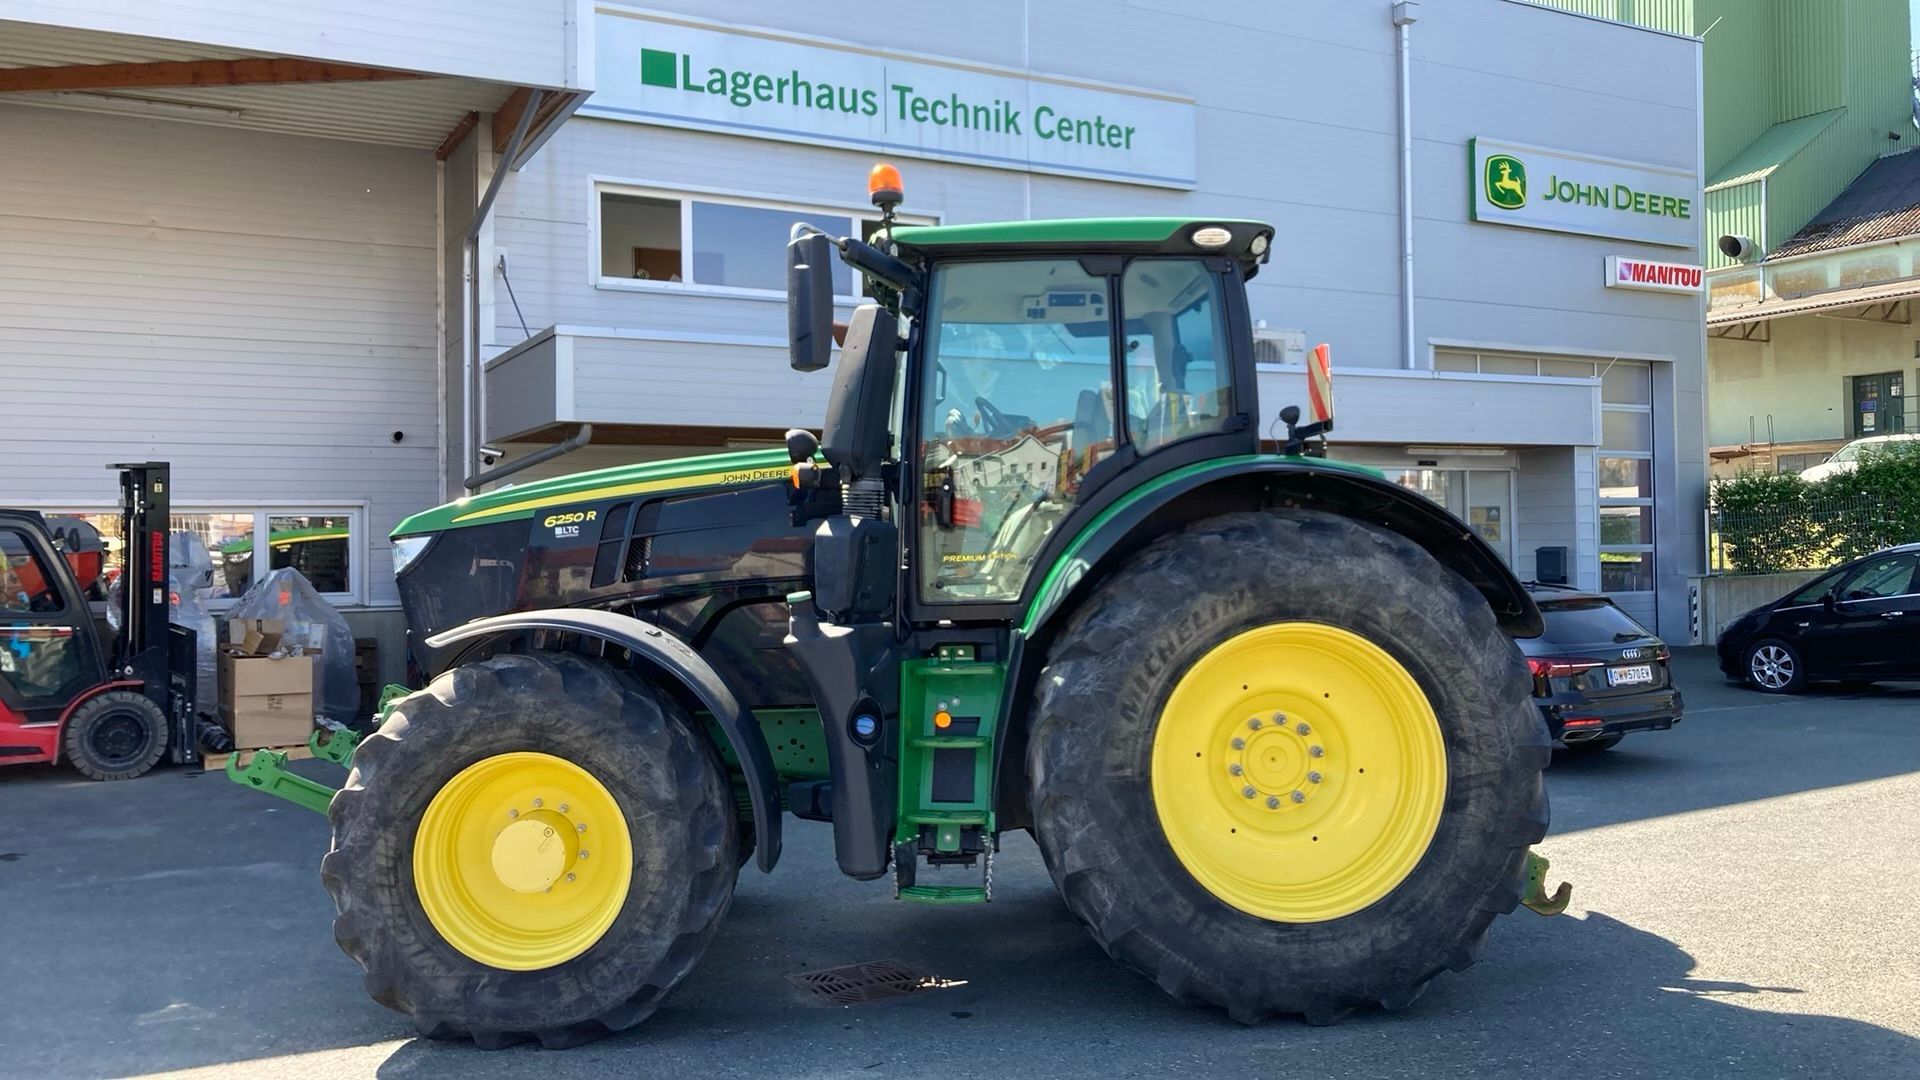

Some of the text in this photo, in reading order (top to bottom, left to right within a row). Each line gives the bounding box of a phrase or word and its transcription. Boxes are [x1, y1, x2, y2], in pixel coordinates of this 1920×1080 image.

[683, 54, 1136, 150] Lagerhaus Technik Center
[1542, 175, 1691, 219] JOHN DEERE
[1631, 263, 1702, 287] MANITOU
[721, 469, 790, 484] JOHN DEERE
[544, 510, 597, 528] 6250 R
[562, 525, 579, 535] LTC
[152, 530, 163, 582] MANITOU
[943, 554, 986, 563] PREMIUM
[1118, 586, 1249, 724] MICHELIN
